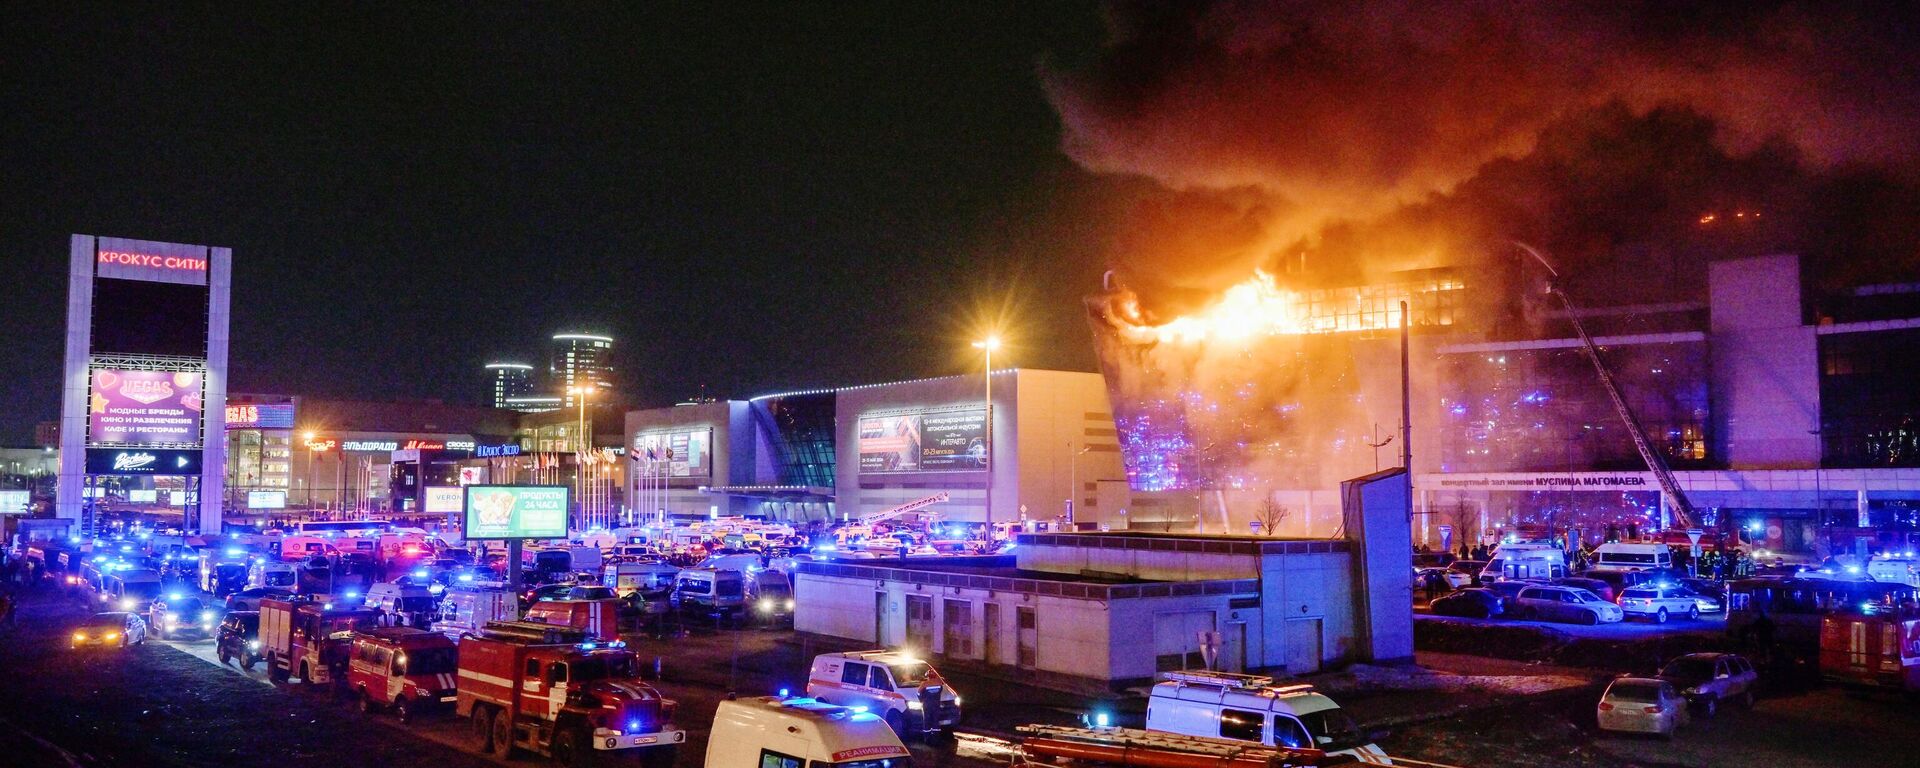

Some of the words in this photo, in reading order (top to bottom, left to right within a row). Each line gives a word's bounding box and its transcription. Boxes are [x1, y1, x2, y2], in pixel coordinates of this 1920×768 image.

[99, 251, 162, 268] КРОКУС
[165, 257, 205, 270] СИТИ
[123, 379, 171, 394] VEGAS
[148, 408, 184, 416] БРЕНДЫ
[225, 406, 258, 423] EGAS
[133, 417, 192, 425] РАЗВЛЕЧЕНИЯ
[1535, 477, 1581, 486] МУСЛИМА
[1583, 477, 1645, 486] МАГОМАЕВА
[436, 493, 462, 501] VERON
[520, 491, 564, 500] ПРОДУКТЫ
[525, 501, 535, 509] 24
[536, 501, 559, 509] ЧАСА
[840, 746, 902, 759] РЕАНИМАЦИЯ
